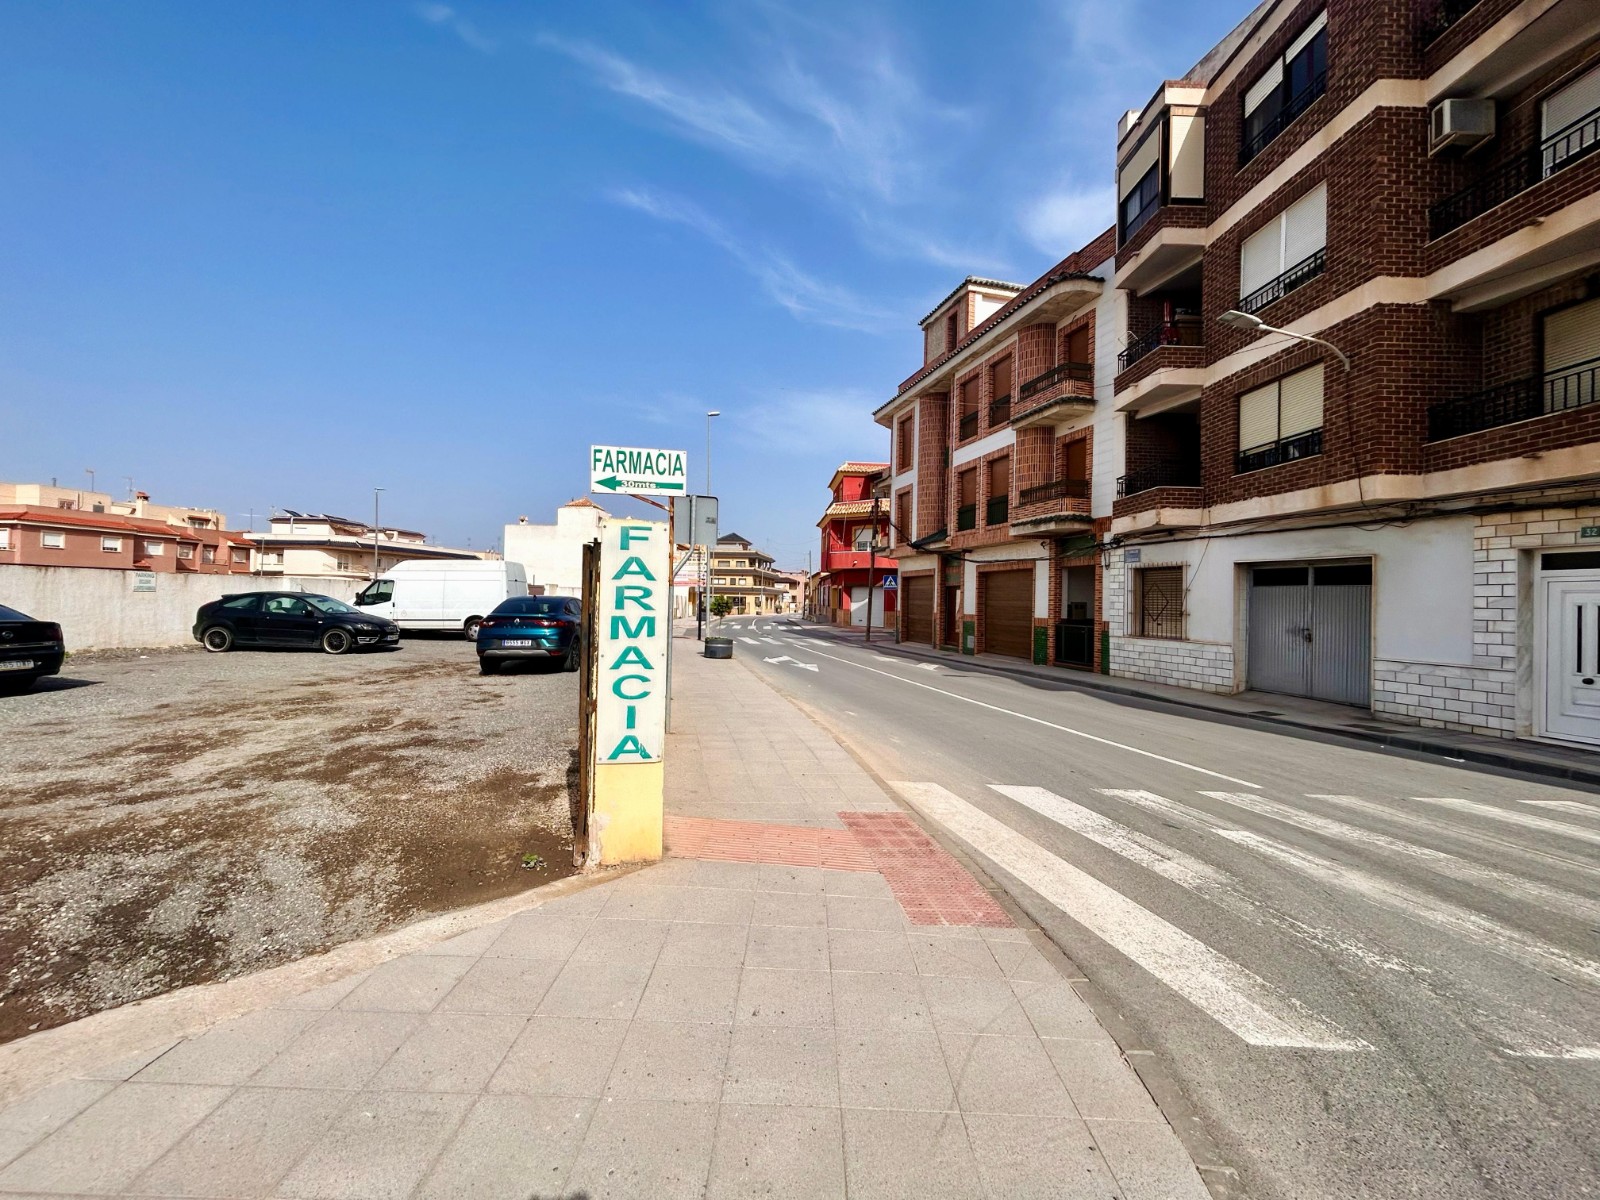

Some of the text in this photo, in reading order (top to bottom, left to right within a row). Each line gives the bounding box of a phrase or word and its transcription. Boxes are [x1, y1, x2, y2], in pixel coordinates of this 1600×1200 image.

[593, 448, 684, 476] FARMACIA
[621, 480, 660, 489] 30mts.
[1584, 528, 1598, 536] 32
[607, 526, 656, 760] FARMACIA
